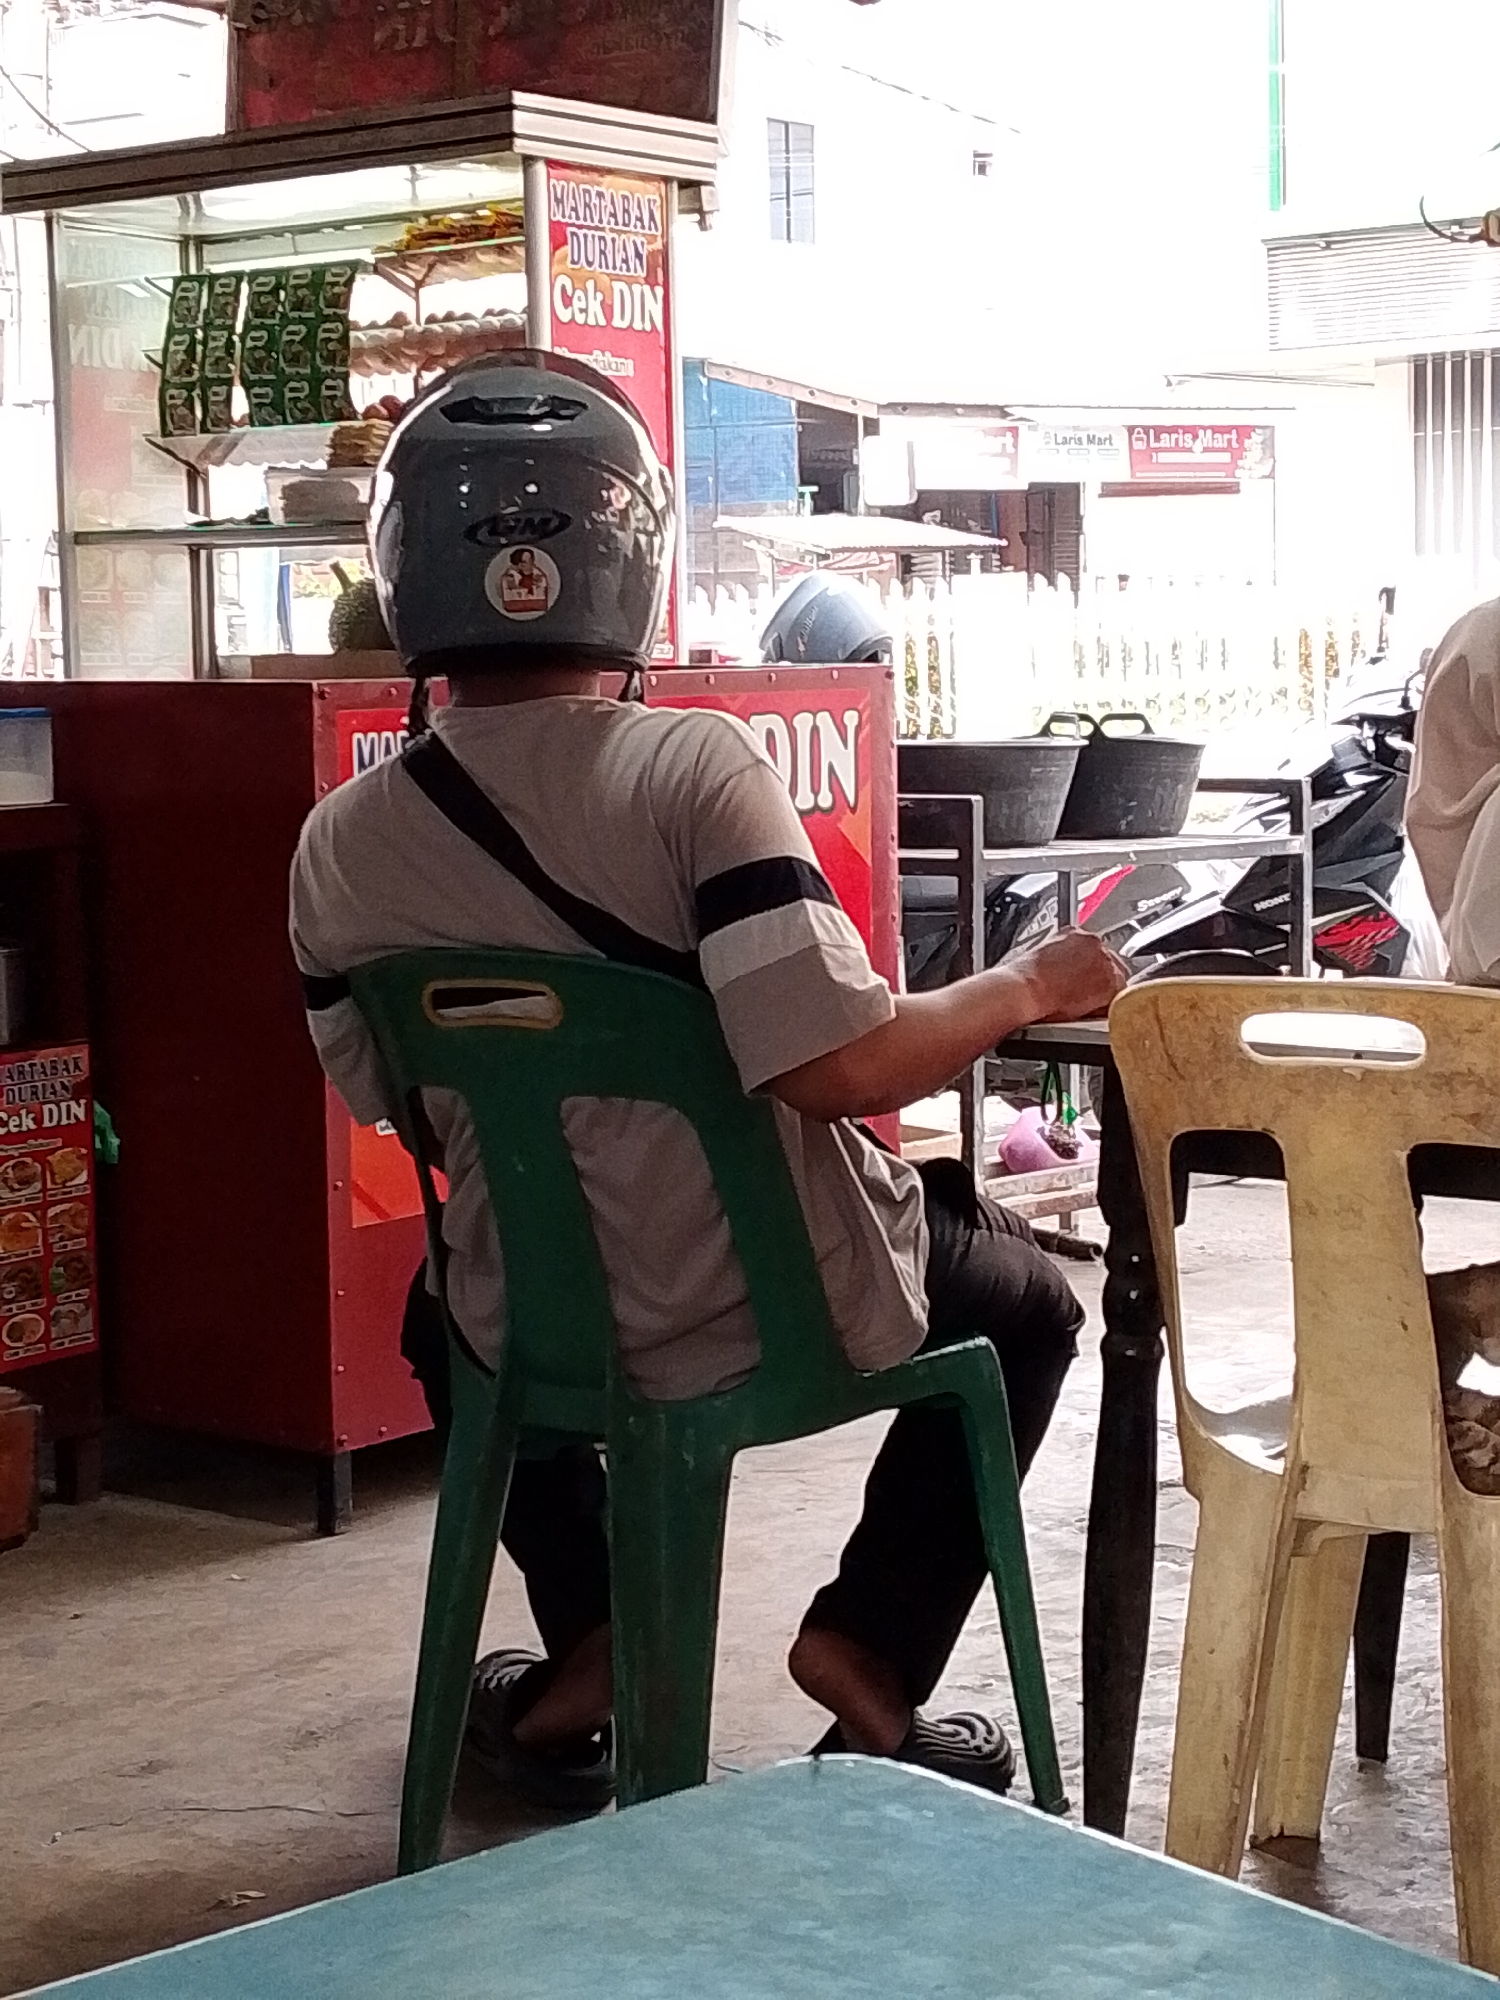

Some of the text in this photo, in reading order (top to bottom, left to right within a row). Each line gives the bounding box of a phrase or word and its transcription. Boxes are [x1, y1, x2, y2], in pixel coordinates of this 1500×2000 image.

[550, 178, 662, 234] MARTABAK
[567, 227, 647, 277] DURIAN
[554, 274, 664, 332] Cek DIN
[1054, 433, 1113, 447] Laris Mart
[1150, 428, 1239, 449] Laris Mart
[0, 1054, 83, 1085] ARTABAK
[4, 1079, 72, 1107] DURIAN
[42, 1099, 87, 1128] DIN
